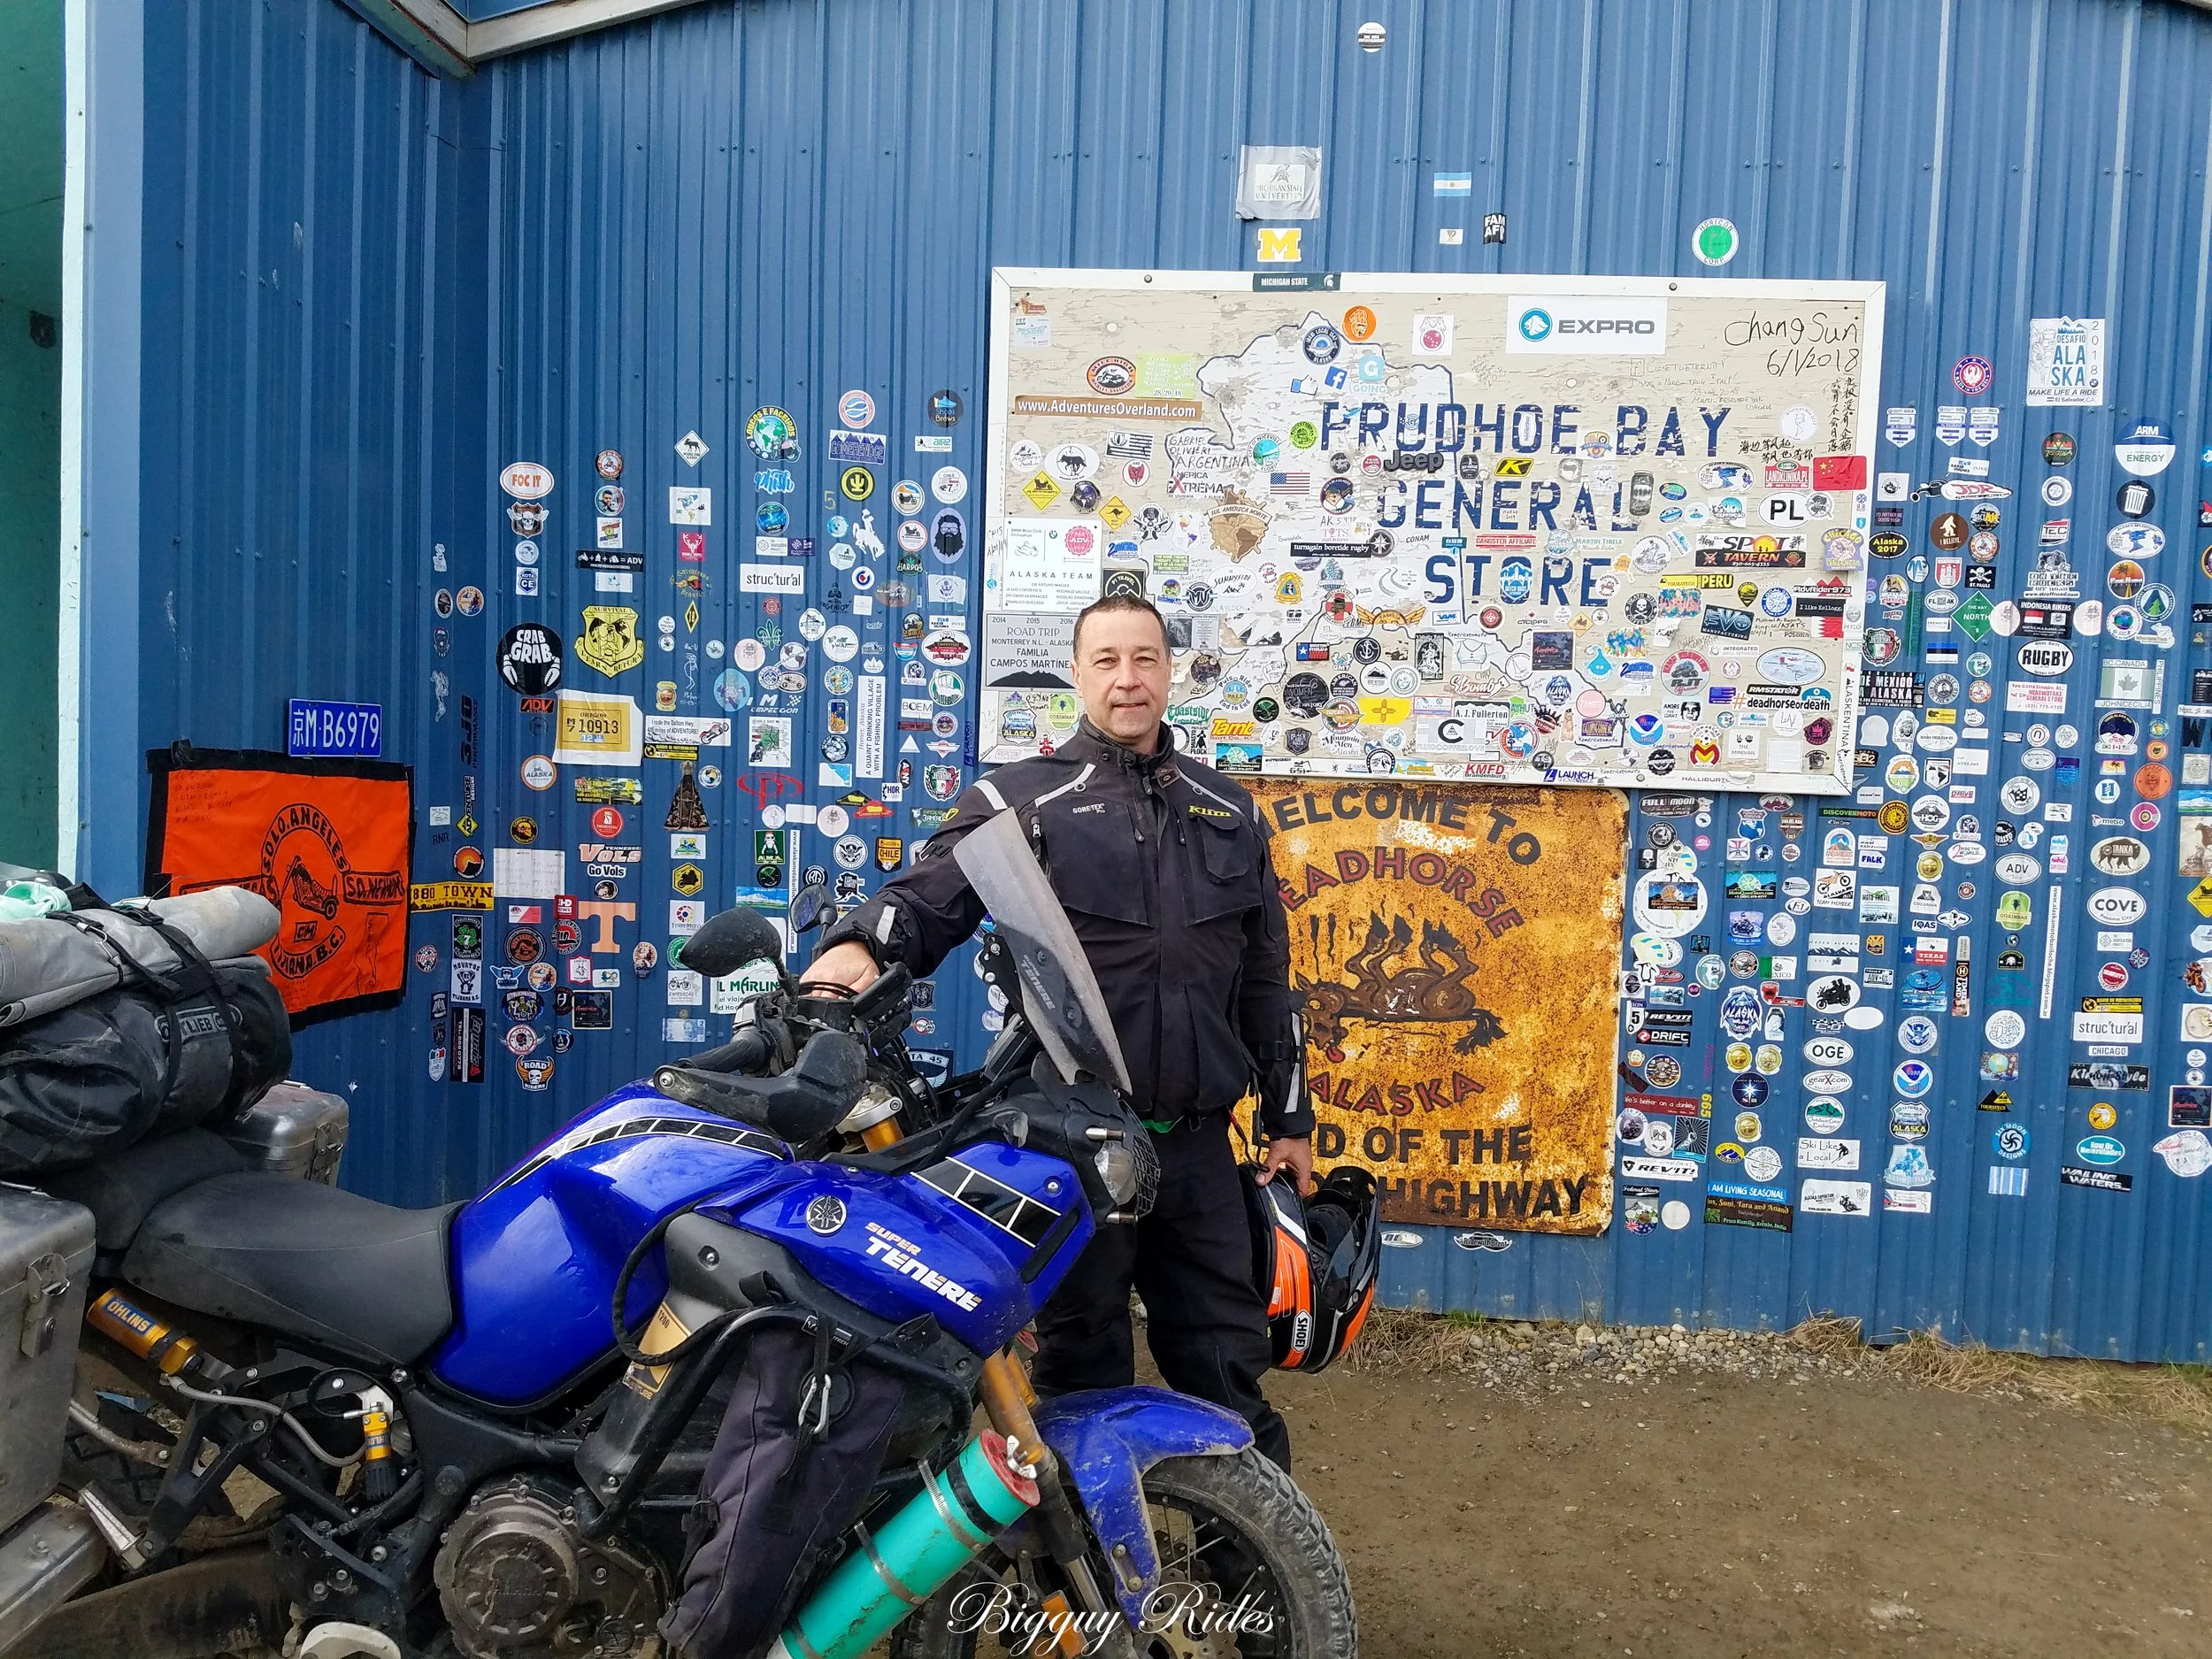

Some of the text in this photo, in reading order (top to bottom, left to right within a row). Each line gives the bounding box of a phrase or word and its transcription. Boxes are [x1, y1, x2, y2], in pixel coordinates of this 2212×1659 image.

[1260, 230, 1300, 260] M
[1261, 277, 1309, 287] MICHIGAN STATE
[1558, 319, 1655, 334] EXPRO
[2057, 334, 2086, 344] DESAFIO
[2053, 346, 2086, 365] ALA
[1767, 347, 1860, 378] 6/1/2018
[2051, 367, 2086, 387] SKA
[1353, 384, 1386, 394] GOING
[1018, 398, 1196, 419] www.AdventuresOverland.com
[1616, 404, 1732, 457] BAY
[2135, 426, 2159, 436] ARM
[1175, 455, 1251, 470] ARGENTINA
[1384, 449, 1444, 473] Jeep
[2126, 453, 2165, 463] ENERGY
[511, 473, 530, 488] FOC
[1764, 469, 1809, 484] LANDKLINIKA.PL
[1376, 479, 1638, 532] GENERAL
[1770, 499, 1804, 521] PL
[2043, 526, 2067, 534] TEC
[1405, 534, 1430, 543] CONAM
[1873, 538, 1903, 547] Alaska
[1293, 543, 1369, 555] turnagain boretide rugby
[1878, 545, 1899, 554] 2017
[626, 557, 643, 565] ADV
[1724, 551, 1780, 563] TAVERN
[520, 580, 534, 588] CE
[1213, 575, 1252, 585] SUNNYSIDE
[1424, 555, 1612, 608] STORE
[1701, 574, 1732, 589] PERU
[1793, 585, 1852, 594] AdvRider973
[2021, 602, 2051, 611] INDONESIA
[516, 629, 545, 644] CRAB
[1006, 626, 1061, 637] ROAD TRIP
[1702, 627, 1749, 640] MANUFACTURING
[991, 638, 1028, 647] MONTERREY
[511, 643, 552, 664] GRAB
[1017, 648, 1049, 657] FAMILIA
[2022, 649, 2070, 667] RUGBY
[990, 657, 1073, 670] CAMPOS MARTÍNE
[2103, 659, 2146, 668] BC.CANADA
[1876, 676, 1914, 688] MEXICO
[1748, 686, 1800, 695] RMSTATOR
[1870, 687, 1912, 700] ALASKA
[521, 699, 553, 710] ADV
[902, 702, 933, 712] BOEM
[1732, 694, 1831, 711] #deadhorseordeath
[1471, 710, 1508, 718] Fullerton
[579, 719, 619, 735] 10913
[1465, 764, 1505, 775] KMFD
[1558, 771, 1594, 780] LAUNCH
[887, 786, 900, 795] HDR
[1641, 797, 1666, 807] FULL
[1188, 804, 1233, 818] Klim
[1823, 809, 1877, 818] DISCOVERMOTO
[1267, 786, 1542, 866] ELCOME TO
[2101, 817, 2125, 826] metso
[579, 845, 641, 863] VOLS
[879, 848, 902, 858] CHILE
[2112, 844, 2134, 855] TANKA
[1861, 855, 1883, 864] FALK
[588, 864, 626, 877] Go Vols
[2006, 863, 2029, 874] ADV
[412, 887, 435, 900] 880
[443, 885, 493, 899] TOWN
[1278, 846, 1525, 939] EADHORSE
[2094, 899, 2138, 912] COVE
[578, 901, 636, 954] T
[1913, 919, 1937, 930] IQAS
[1021, 962, 1056, 1010] TENERE
[1812, 1045, 1845, 1059] OGE
[2092, 1047, 2126, 1056] CHICAGO
[523, 1061, 551, 1070] ROAD
[1309, 1071, 1486, 1118] ALASKA
[1252, 1110, 1534, 1164] ED OF THE
[1799, 1140, 1839, 1150] Ski Like
[1806, 1151, 1832, 1162] Local
[2062, 1166, 2117, 1182] WAILING
[2069, 1176, 2122, 1190] WATERS
[1378, 1176, 1588, 1219] HIGHWAY
[1725, 1185, 1785, 1199] LIVING SEASONAL
[865, 1220, 922, 1257] SUPER
[864, 1235, 982, 1311] TENERE
[107, 1297, 152, 1334] ÖHLINS
[657, 1309, 671, 1330] 1200
[1295, 1317, 1309, 1348] SHOEI
